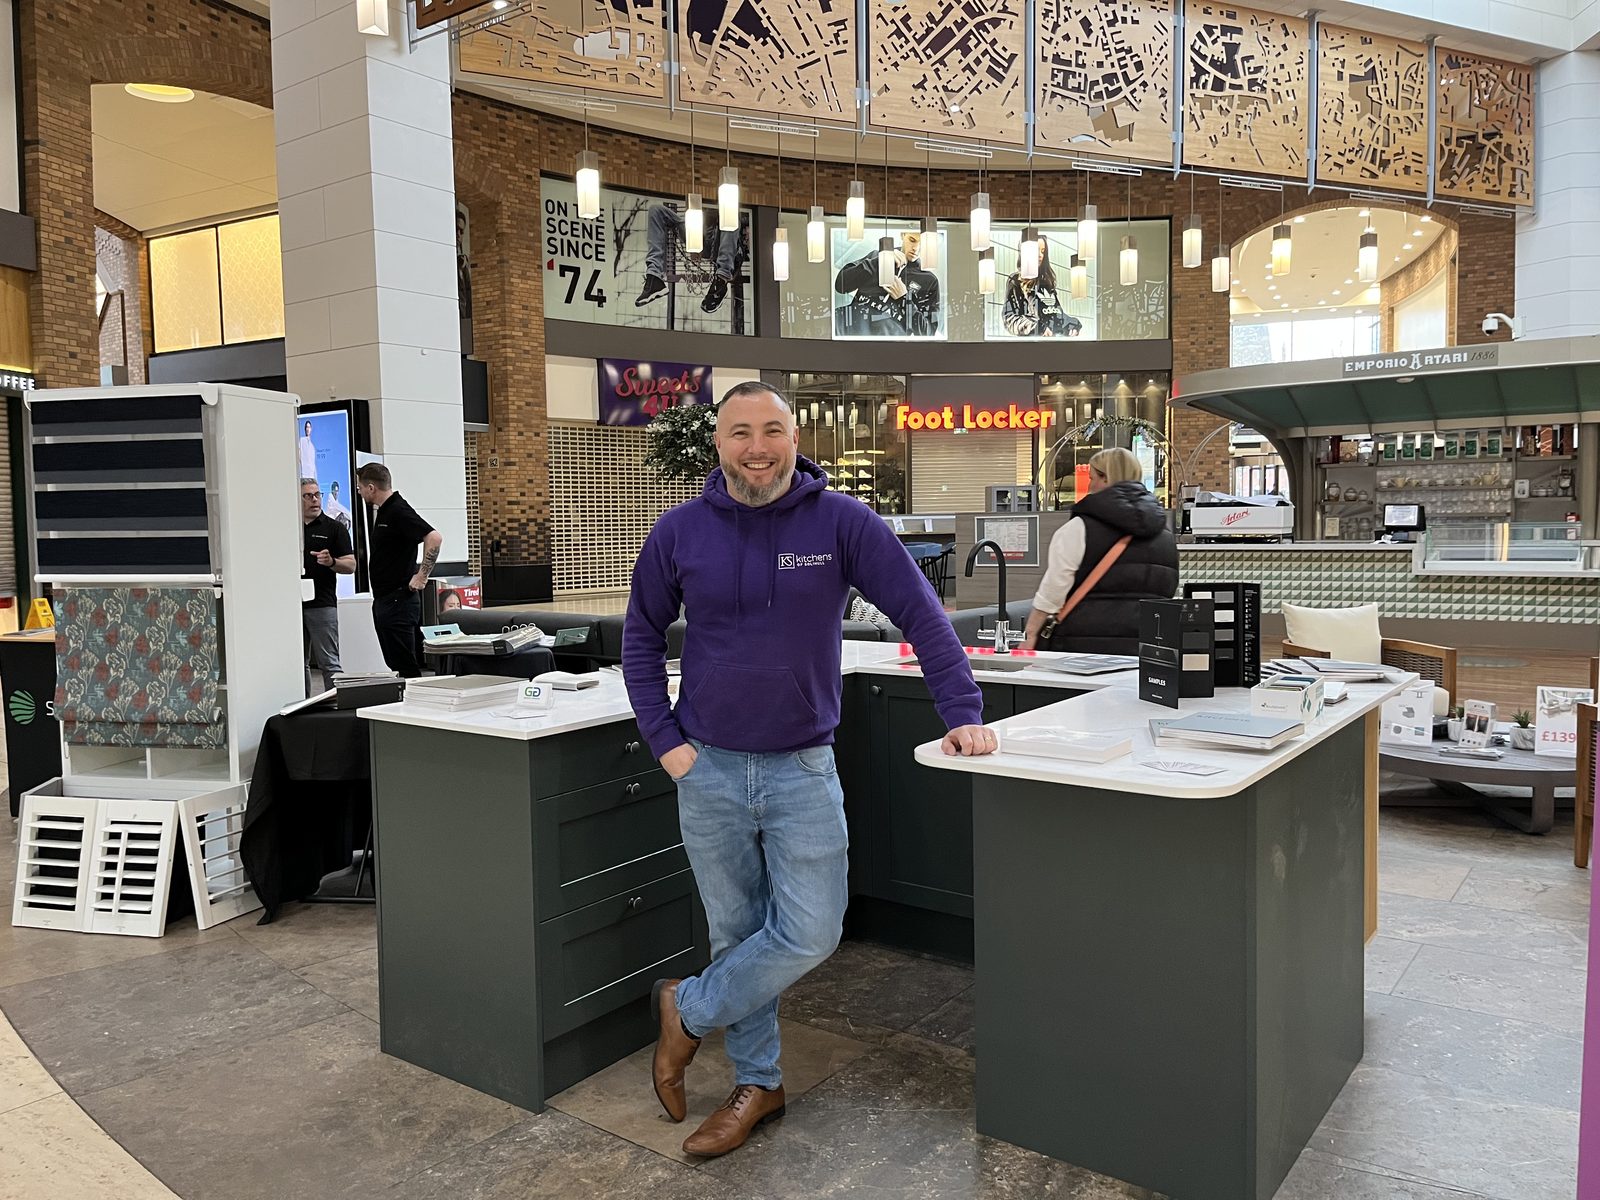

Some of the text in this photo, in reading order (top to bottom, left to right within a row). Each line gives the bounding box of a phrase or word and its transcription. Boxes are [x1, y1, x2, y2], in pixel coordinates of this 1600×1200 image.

[545, 199, 605, 223] ON TE
[546, 217, 605, 242] SCENE
[547, 237, 606, 262] SINCE
[1345, 351, 1495, 372] EMPORIO ARTARI 1886
[0, 374, 35, 390] FFEE
[615, 367, 702, 397] Sweets
[896, 404, 1052, 430] Foot Locker
[780, 553, 833, 567] KS kitchens
[464, 588, 480, 597] Tired
[1148, 676, 1166, 687] SAMPLES
